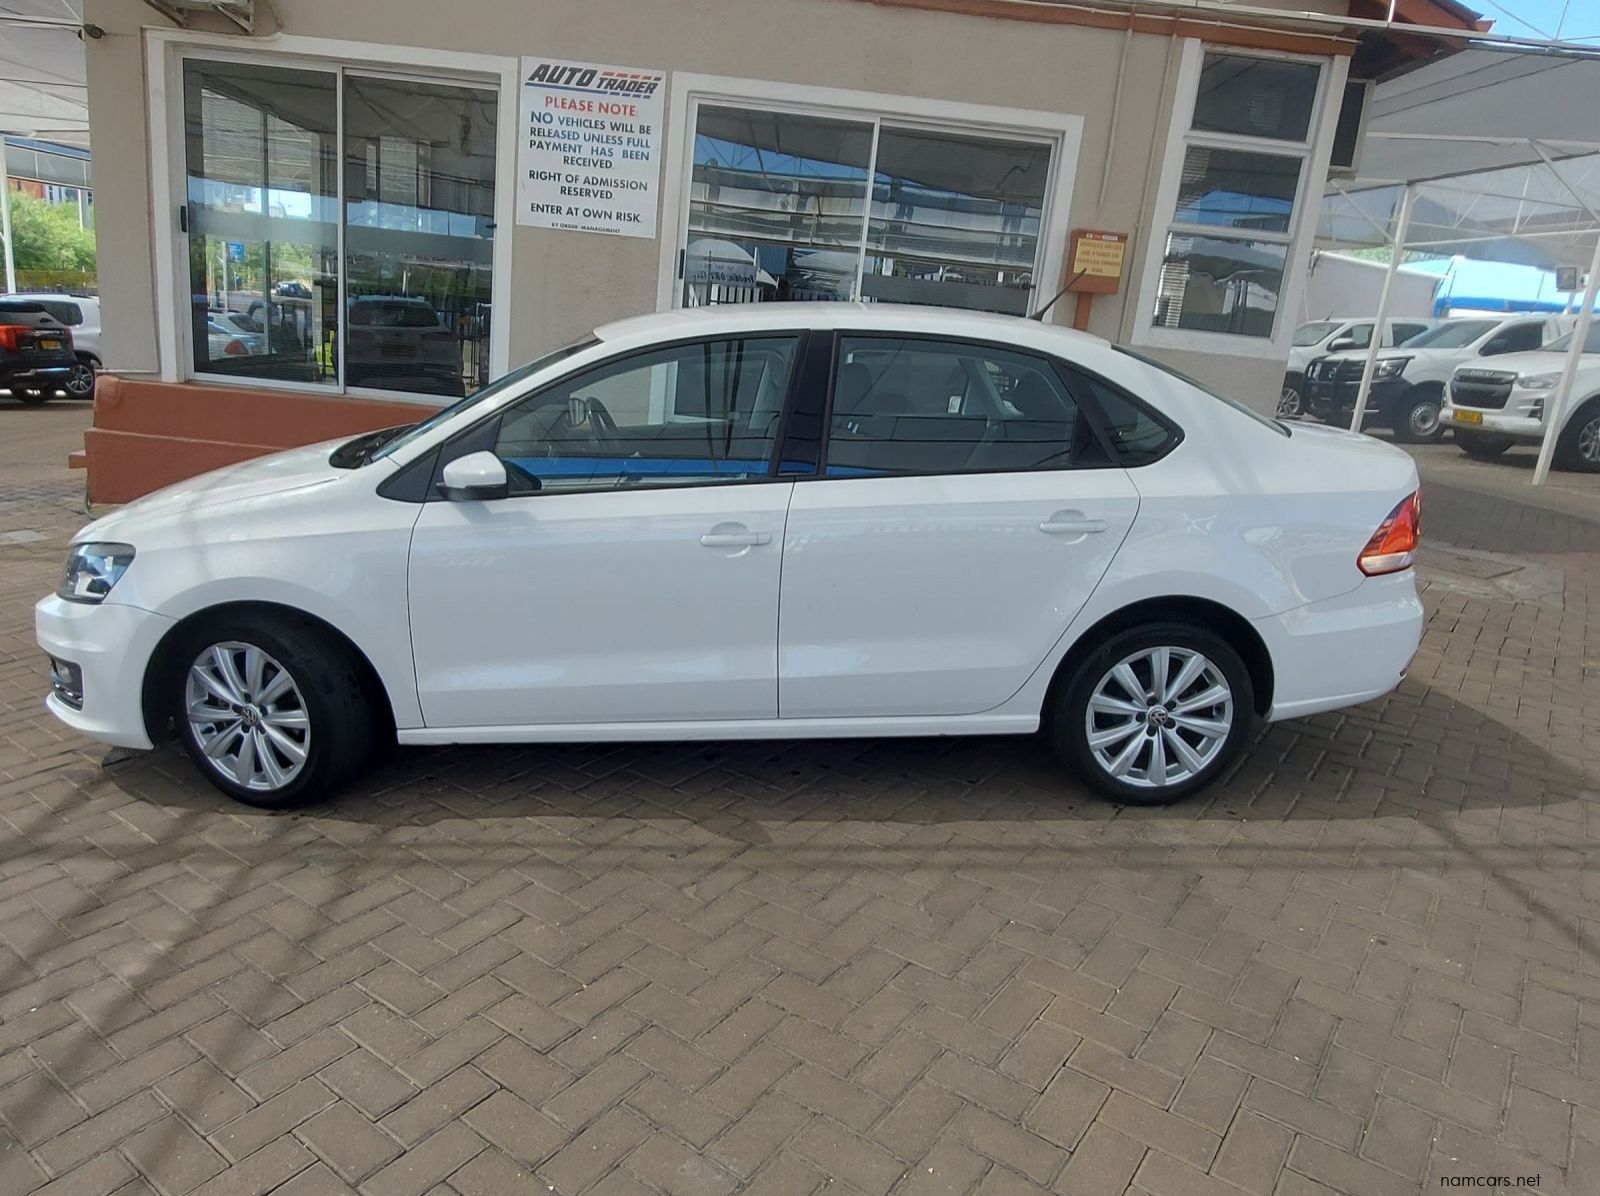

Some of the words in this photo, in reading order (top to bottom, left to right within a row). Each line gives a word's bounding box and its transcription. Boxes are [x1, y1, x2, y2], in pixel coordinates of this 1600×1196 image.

[528, 64, 598, 87] AUTO
[596, 77, 658, 94] TRADER
[545, 95, 593, 112] PLEASE
[530, 110, 553, 124] NO
[558, 115, 606, 130] VEHICLES
[610, 121, 635, 133] WILL
[639, 124, 651, 135] BE
[530, 126, 580, 141] RELEASED
[583, 132, 623, 146] UNLESS
[626, 137, 650, 149] FULL
[529, 139, 583, 155] PAYMENT
[591, 146, 614, 157] HAS
[622, 149, 650, 161] BEEN
[528, 169, 562, 183] RIGHT
[565, 173, 580, 184] OF
[583, 175, 648, 191] ADMISSION
[530, 202, 563, 215] ENTER
[566, 206, 580, 217] AT
[582, 208, 612, 220] OWN
[581, 224, 621, 234] MANAGEMENT
